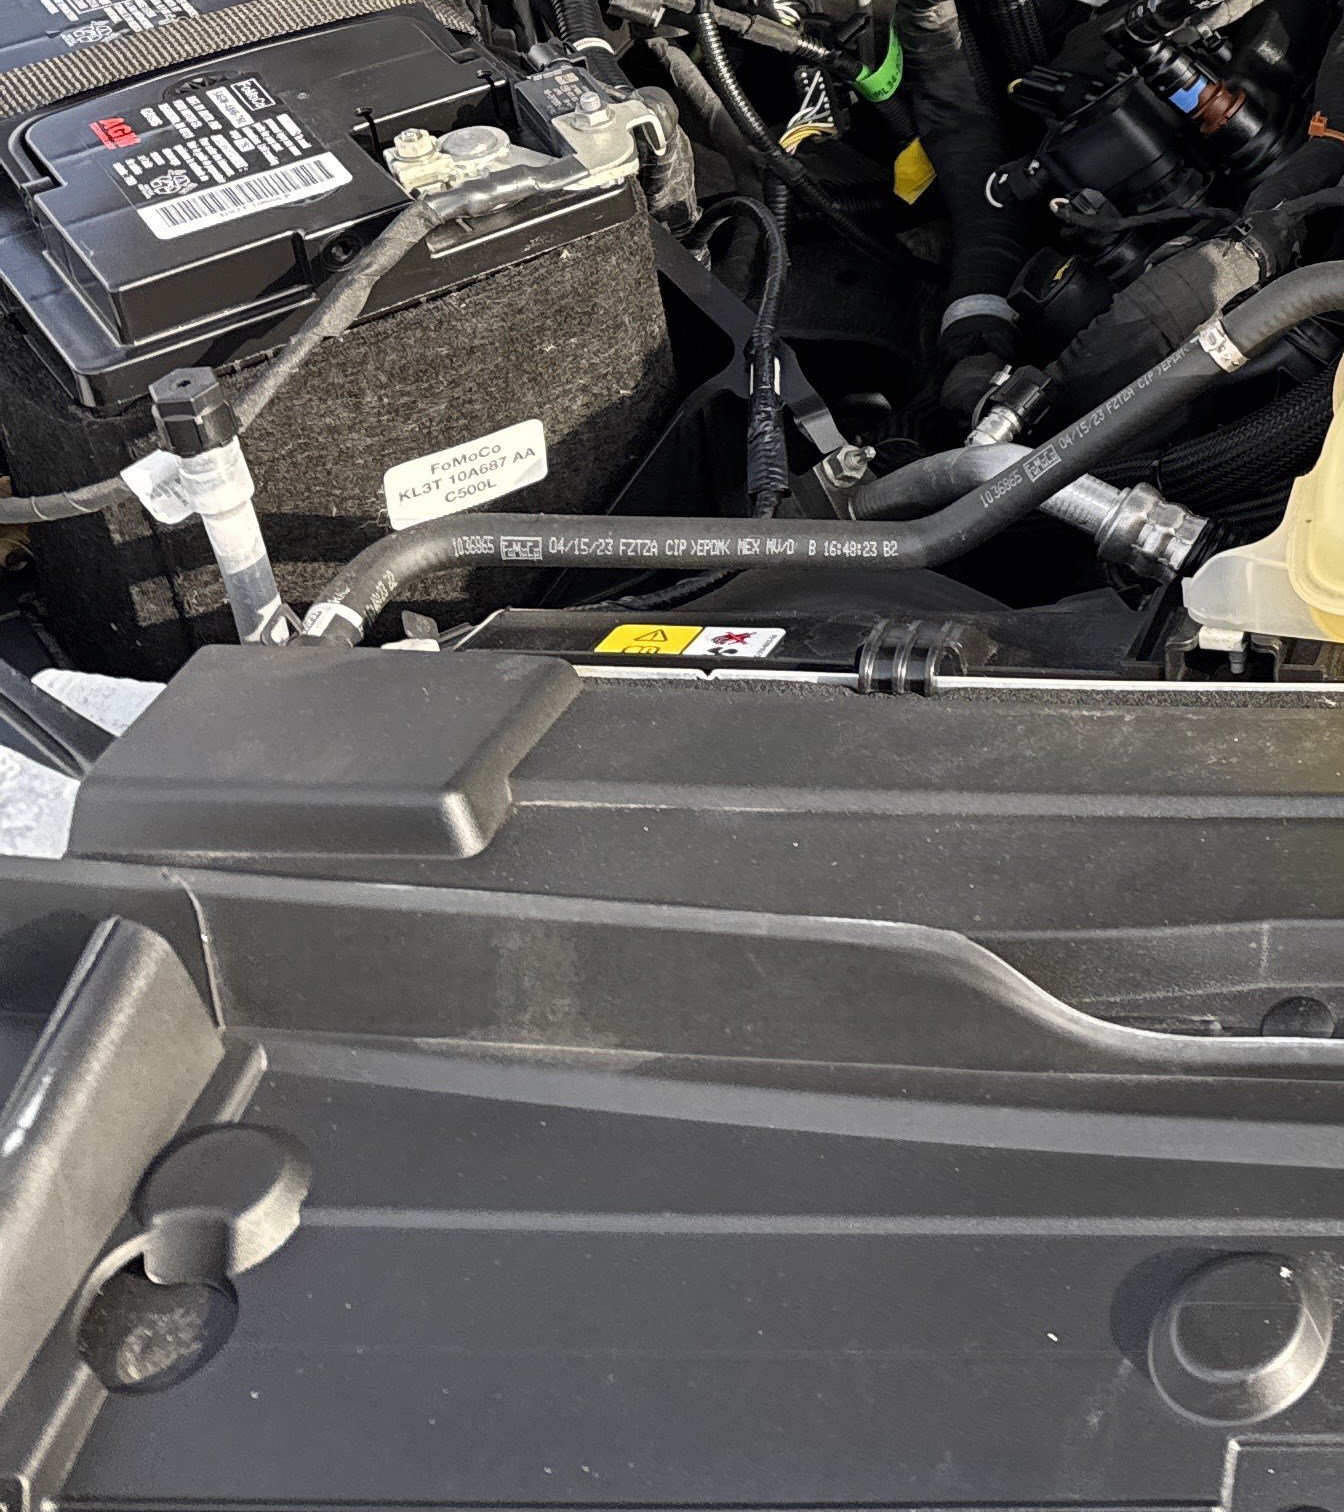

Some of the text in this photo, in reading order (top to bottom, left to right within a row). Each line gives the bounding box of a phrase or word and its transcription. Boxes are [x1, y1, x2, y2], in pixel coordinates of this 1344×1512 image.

[1058, 408, 1106, 450] 04/15/23
[1138, 372, 1154, 389] CIP
[398, 447, 536, 502] KL3T 10A687 AA
[430, 444, 502, 475] FoMoCo
[444, 478, 498, 503] C500L
[549, 536, 613, 555] 04/15/23
[665, 539, 687, 556] CIP
[737, 538, 760, 556] MEX
[808, 540, 816, 555] B
[823, 540, 877, 557] 16:48:23
[883, 540, 899, 557] B2
